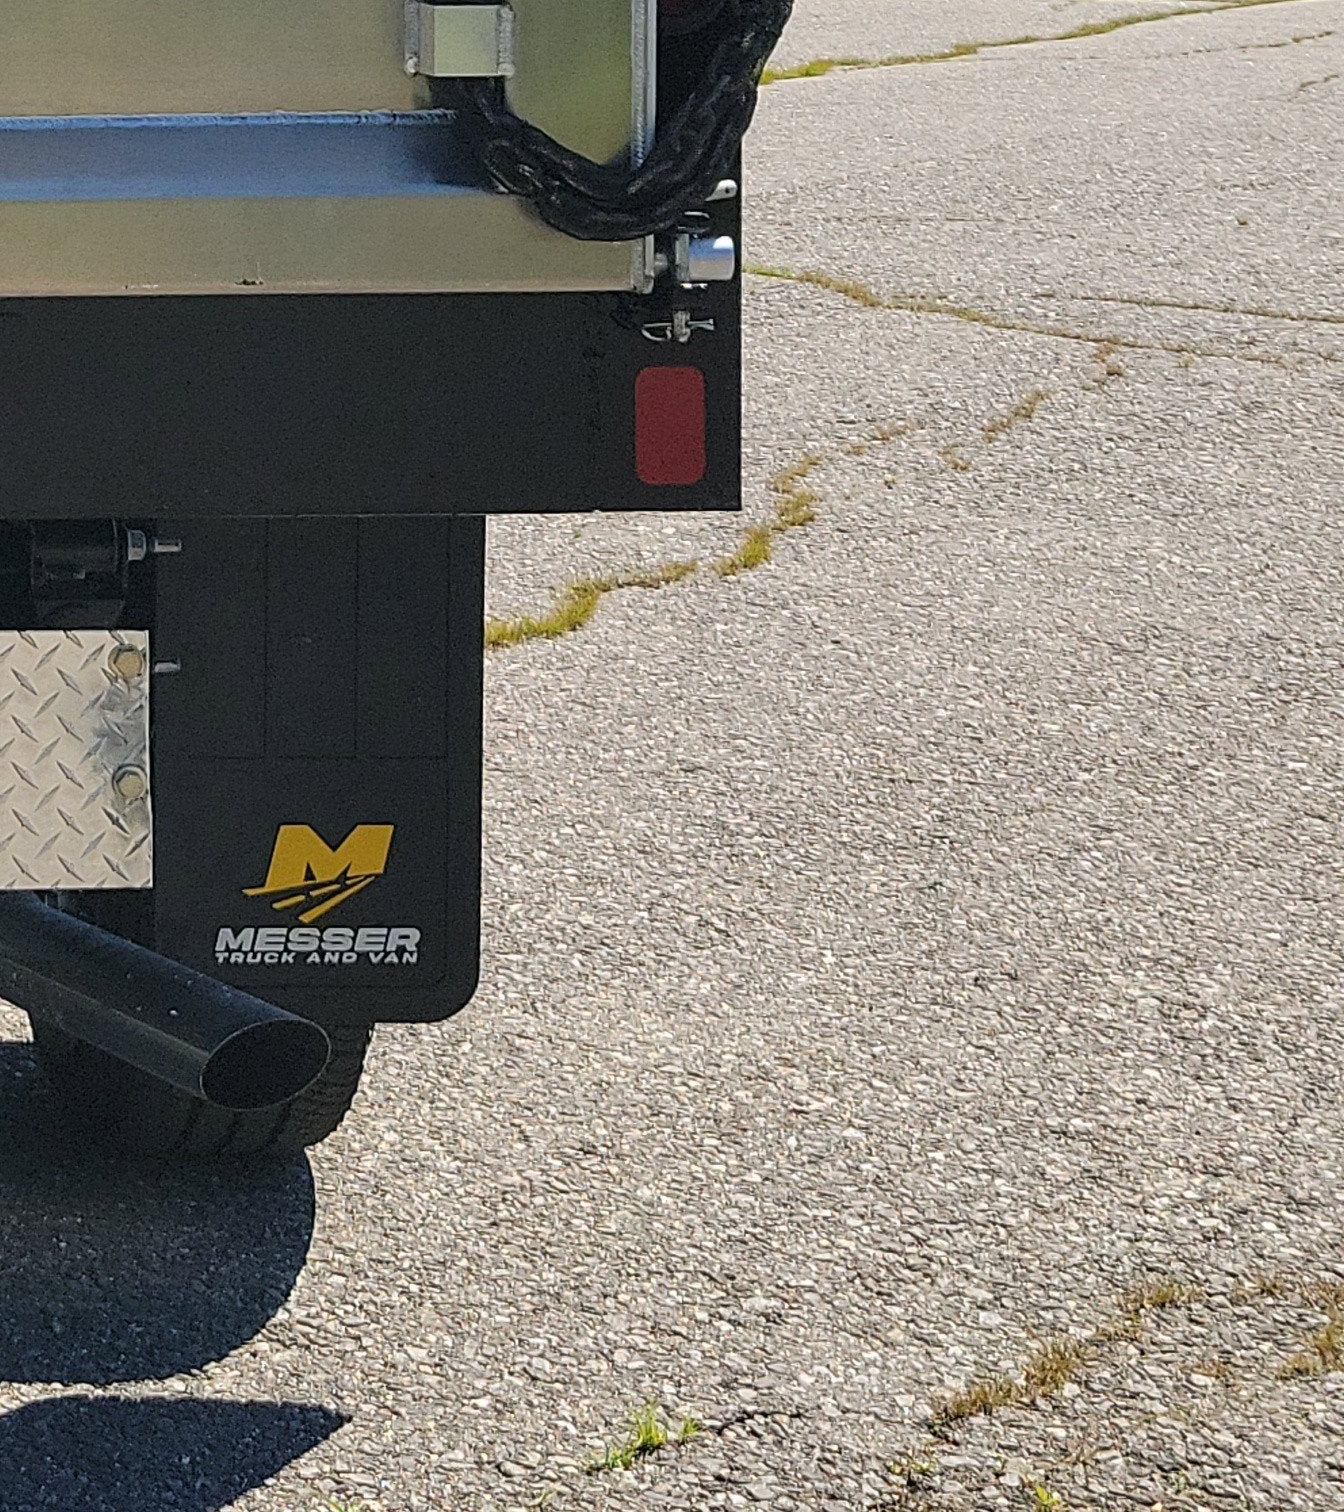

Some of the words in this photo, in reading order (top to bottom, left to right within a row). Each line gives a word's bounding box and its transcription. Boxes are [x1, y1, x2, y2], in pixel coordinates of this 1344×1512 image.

[214, 927, 422, 952] MESSER
[214, 951, 297, 964] TRUCK
[305, 951, 358, 964] AND
[368, 951, 419, 964] VAN
